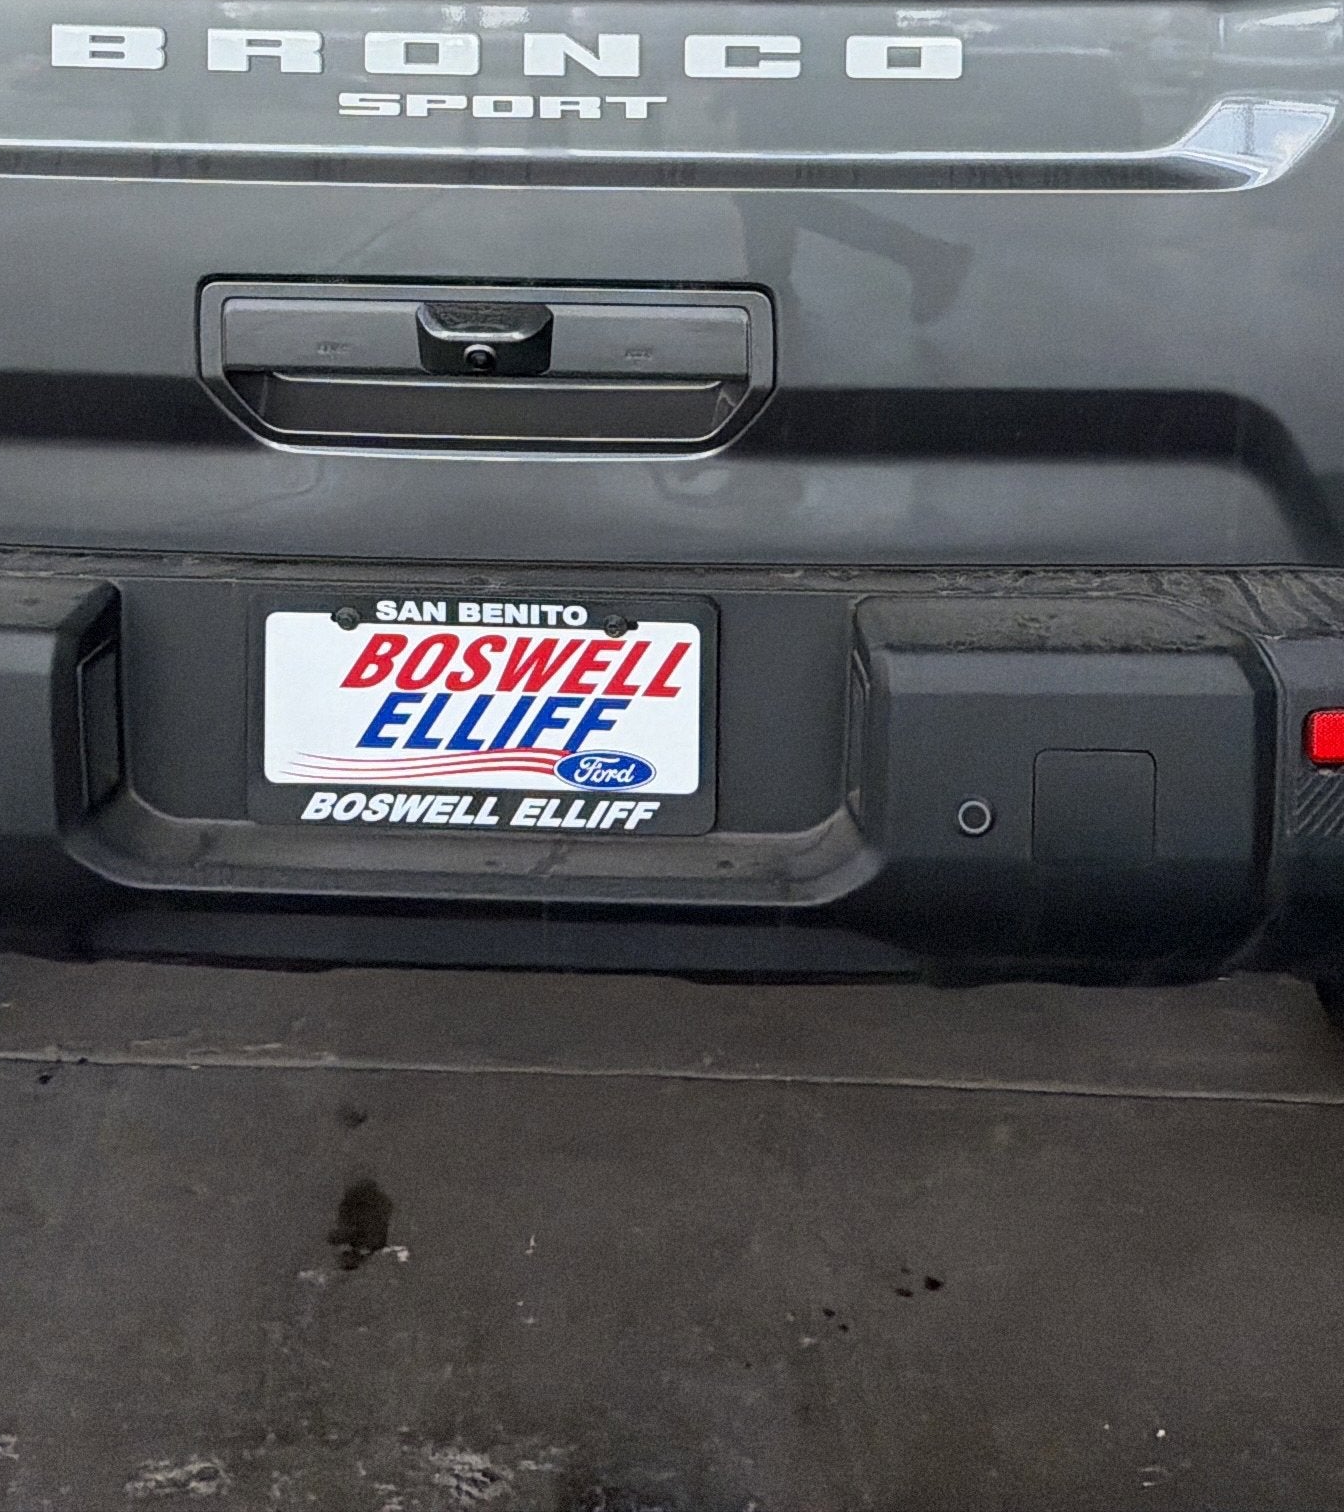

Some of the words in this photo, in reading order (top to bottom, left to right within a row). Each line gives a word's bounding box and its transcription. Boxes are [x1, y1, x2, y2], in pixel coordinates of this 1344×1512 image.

[50, 23, 964, 79] BRONCO
[338, 92, 668, 119] SPORT
[375, 600, 447, 622] SAN
[458, 602, 589, 626] BENITO
[340, 633, 692, 698] BOSWELL
[355, 692, 633, 754] ELLIFF
[572, 760, 636, 785] Ford
[300, 792, 500, 826] BOSWELL
[509, 799, 661, 830] ELLIFF
